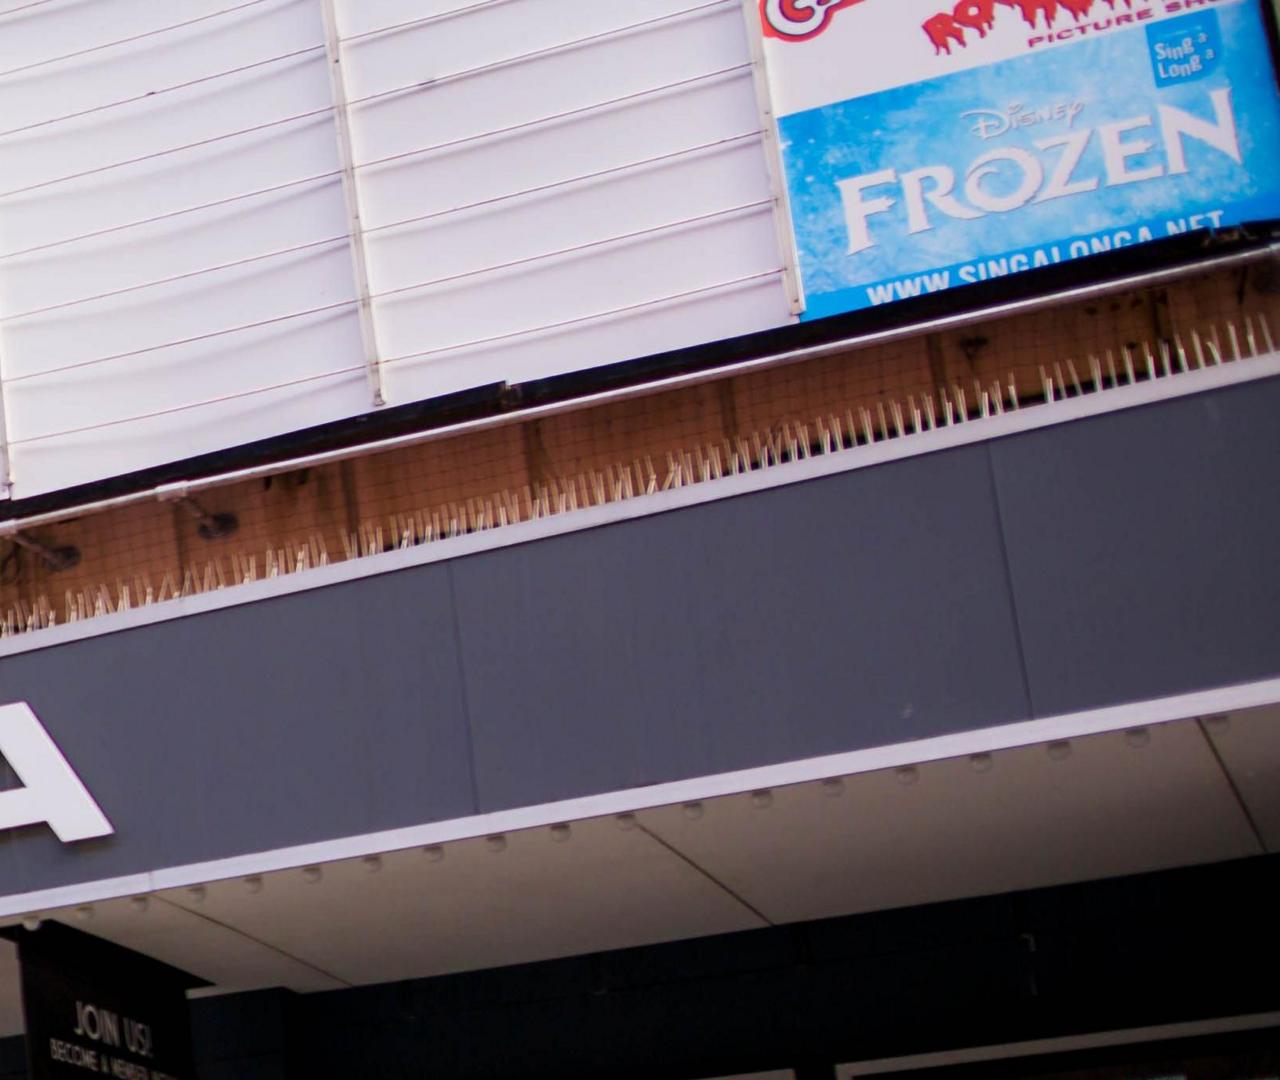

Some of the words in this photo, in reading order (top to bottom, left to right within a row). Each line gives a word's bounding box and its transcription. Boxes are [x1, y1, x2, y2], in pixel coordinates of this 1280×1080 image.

[1027, 8, 1153, 48] PICTURE
[1153, 38, 1196, 63] Sing
[1158, 54, 1203, 79] Long
[834, 86, 1244, 256] FROZEN
[73, 1000, 122, 1048] JOIN
